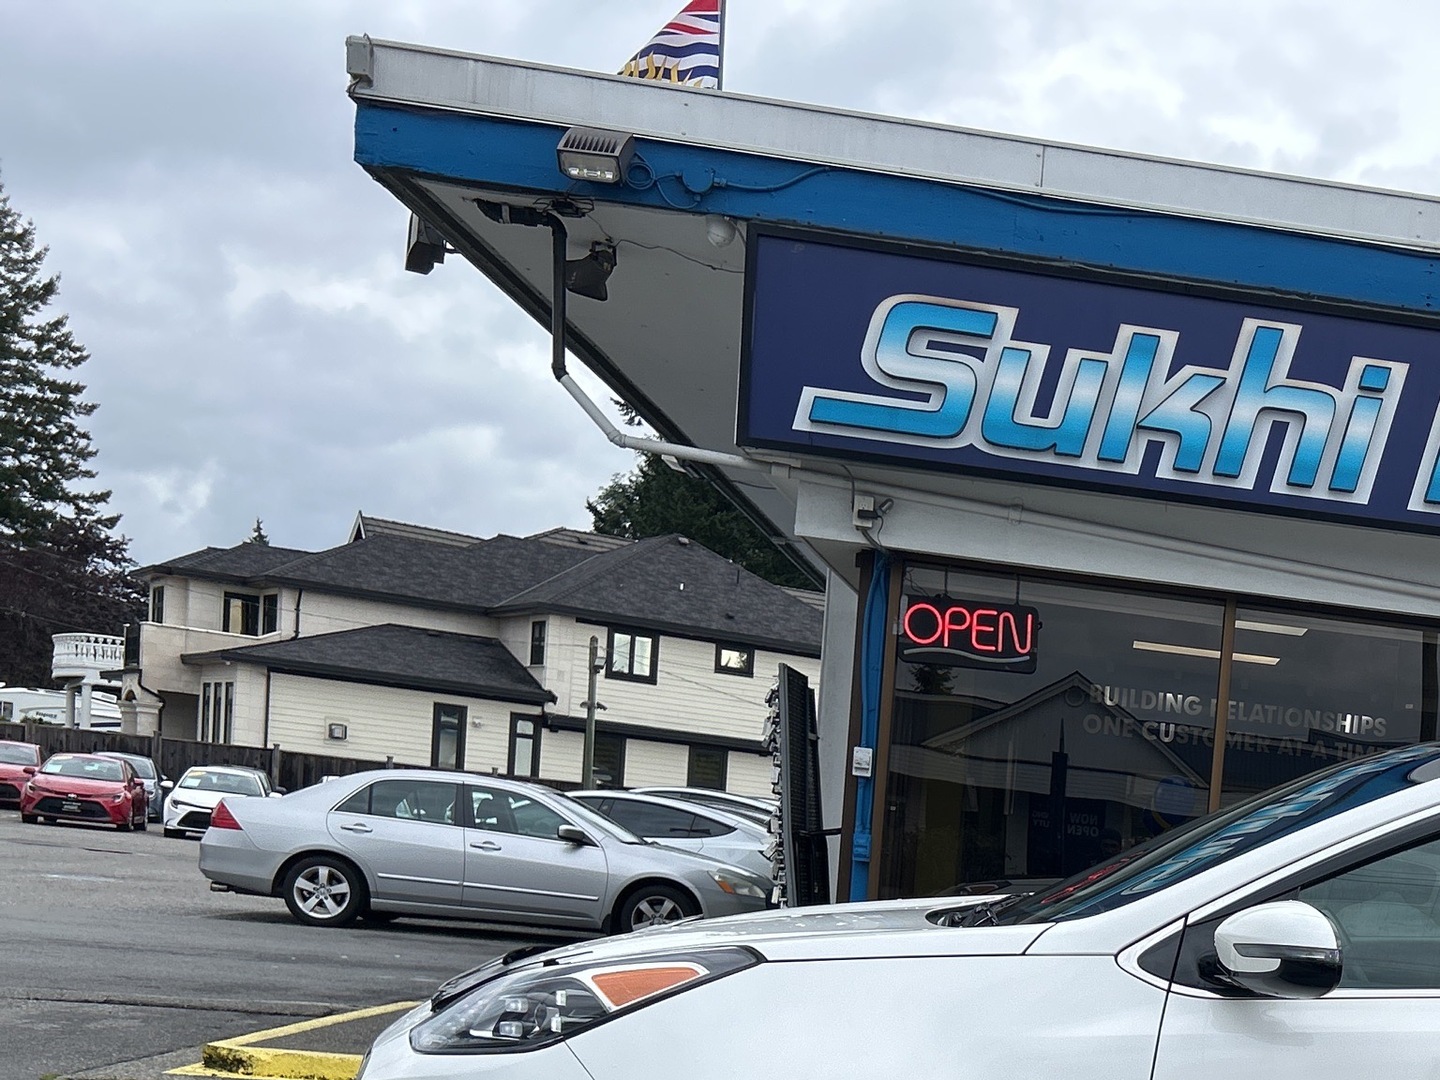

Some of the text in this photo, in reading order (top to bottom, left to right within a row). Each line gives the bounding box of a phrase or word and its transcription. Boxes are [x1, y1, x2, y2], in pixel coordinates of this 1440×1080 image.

[792, 294, 1410, 505] Sukhi
[904, 603, 1032, 654] OPEN
[1082, 714, 1134, 739] ONE
[1089, 684, 1387, 737] BUILDING ELATIONSHIPS
